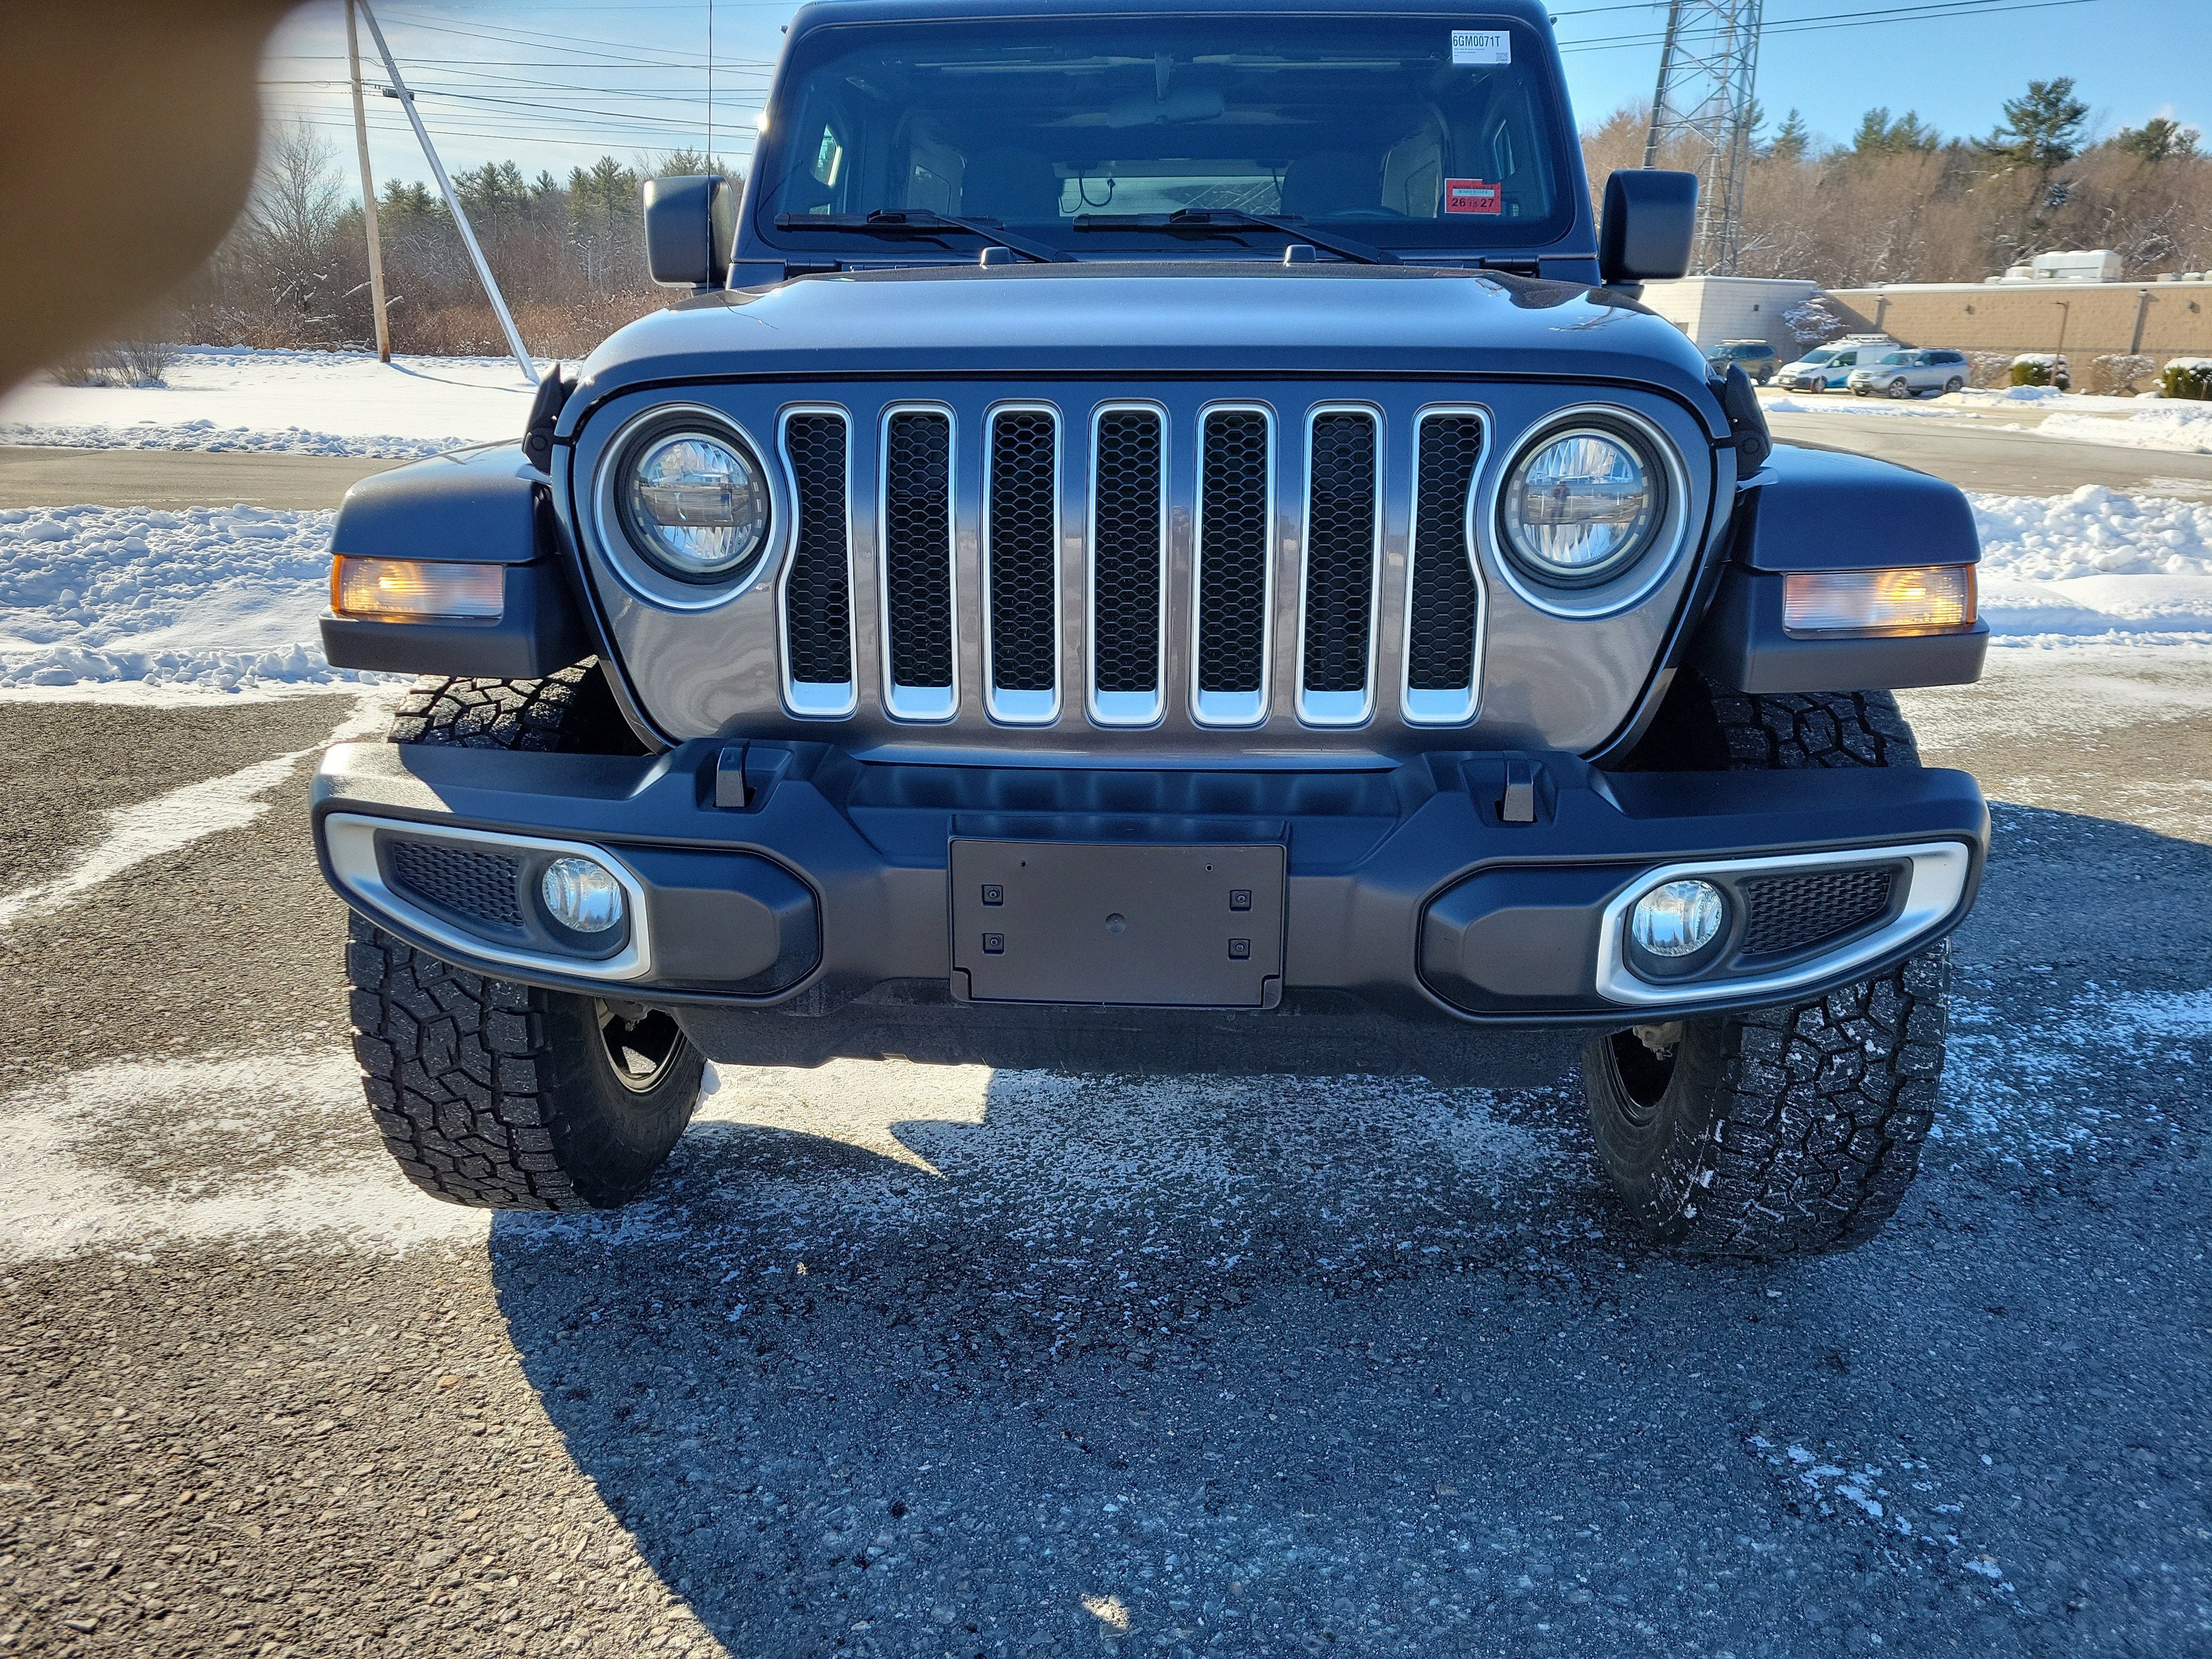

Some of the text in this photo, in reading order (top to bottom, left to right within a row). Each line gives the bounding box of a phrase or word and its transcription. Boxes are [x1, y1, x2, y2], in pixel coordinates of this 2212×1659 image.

[1453, 35, 1500, 47] 6GM0071T
[1452, 198, 1466, 207] 26
[1480, 198, 1494, 207] 27
